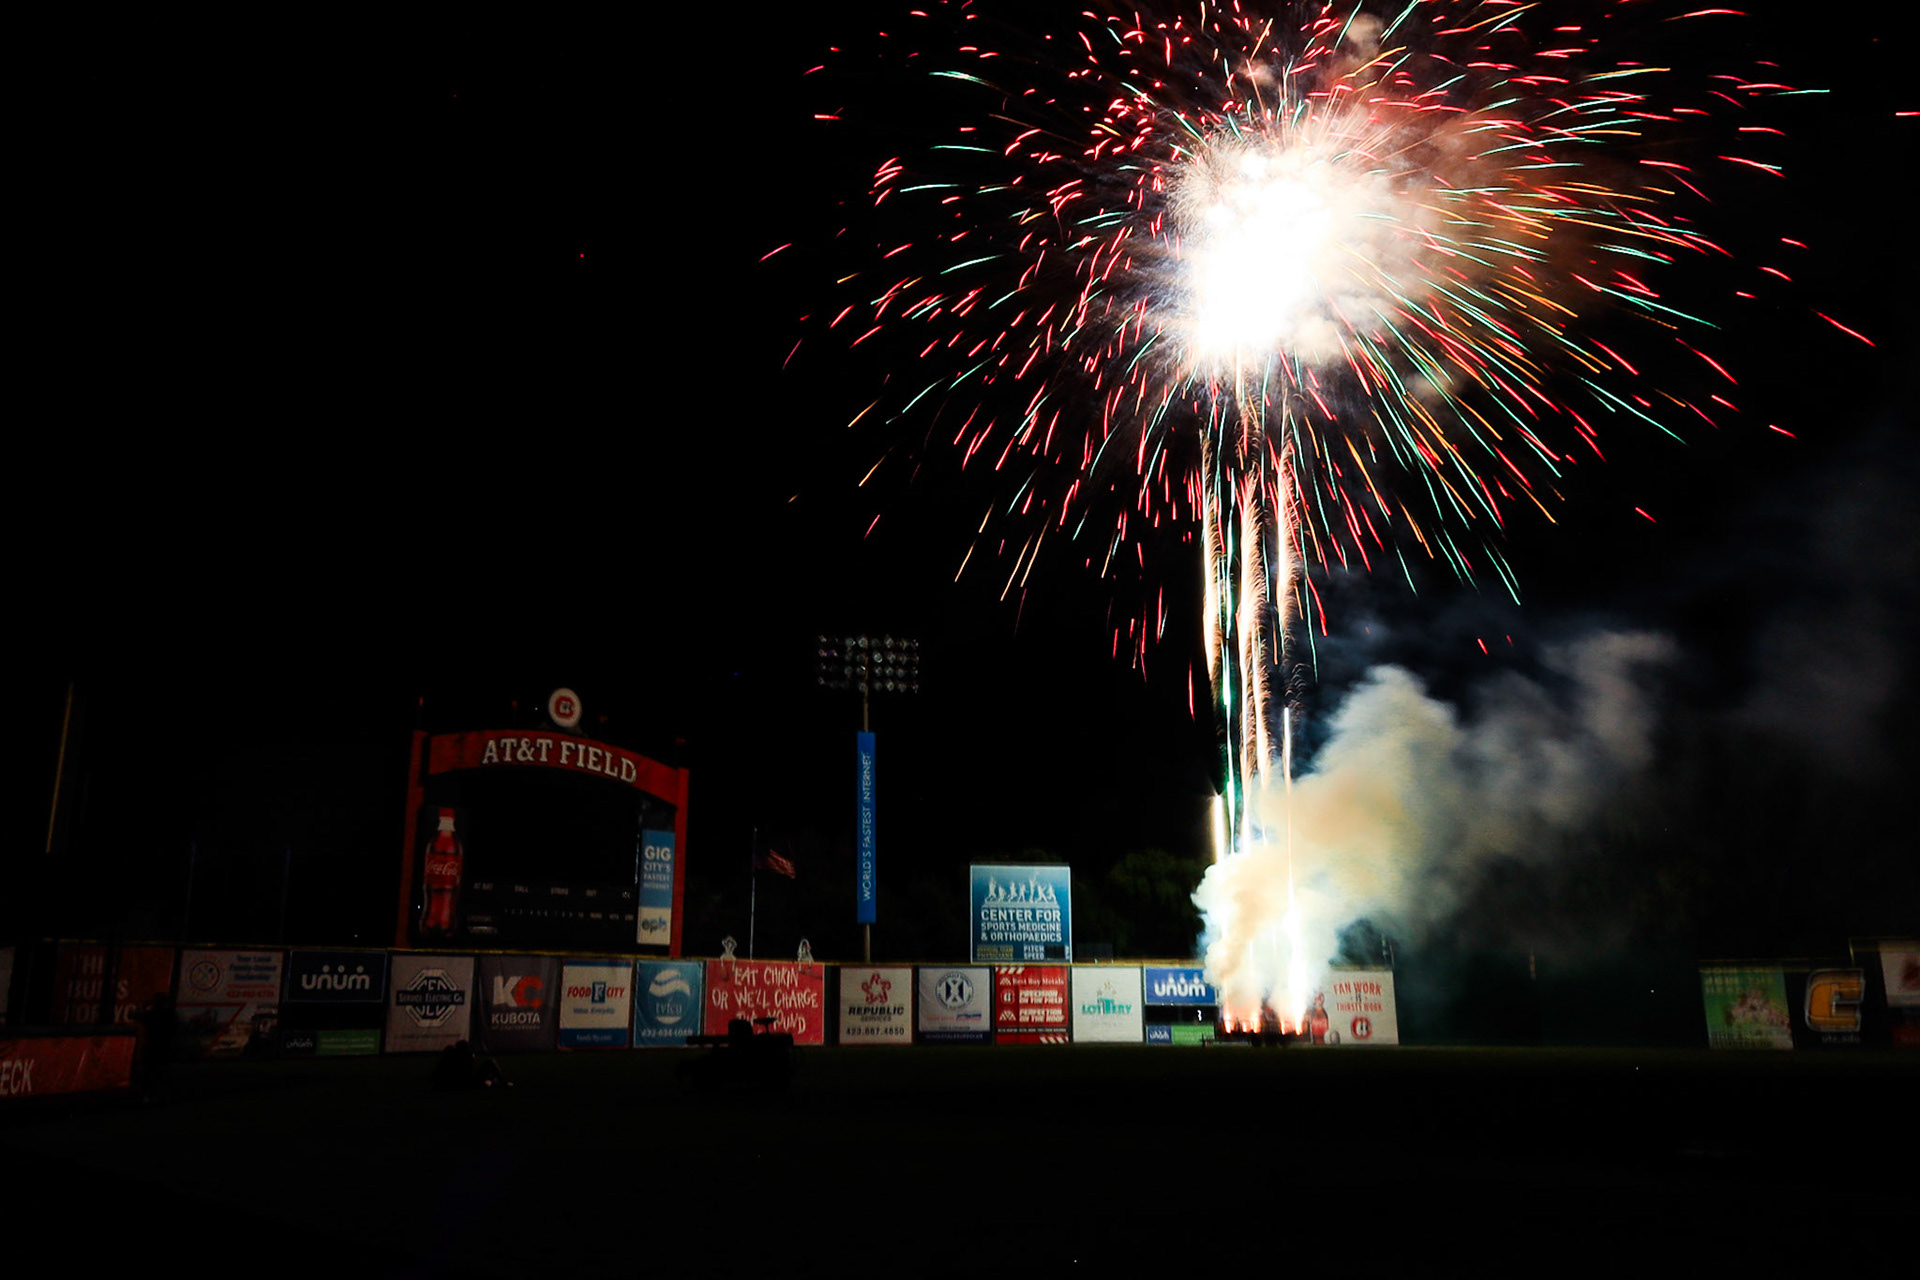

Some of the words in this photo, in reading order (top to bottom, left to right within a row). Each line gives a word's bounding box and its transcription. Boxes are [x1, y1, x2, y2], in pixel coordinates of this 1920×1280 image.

[482, 737, 553, 764] AT&T
[560, 740, 637, 784] FIELD
[861, 751, 873, 803] INTERNET
[862, 805, 873, 848] FASTEST
[644, 844, 672, 862] GIG
[643, 861, 671, 874] CITY'S
[862, 850, 873, 902] WORLD'S
[981, 909, 1032, 921] CENTER
[1036, 909, 1061, 921] FOR
[981, 922, 1016, 932] SPORTS
[1018, 922, 1061, 932] MEDICINE
[981, 932, 988, 941] &
[991, 932, 1062, 942] ORTHOPAEDICS
[1023, 944, 1045, 952] PITCH
[1023, 952, 1045, 960] SPEED
[301, 964, 371, 991] unum
[734, 967, 759, 987] EAT
[764, 966, 799, 989] CHIKIN
[567, 986, 592, 998] FOOD
[606, 987, 625, 998] CITY
[1154, 975, 1206, 997] unum
[1333, 983, 1351, 995] FAN
[1353, 982, 1381, 996] WORK
[712, 987, 729, 1011] OR
[734, 986, 771, 1010] WE'LL
[774, 987, 819, 1010] CHARGE
[848, 1006, 905, 1016] REPUBLIC
[1363, 1002, 1382, 1012] WORK
[491, 1012, 541, 1025] KUBOTA
